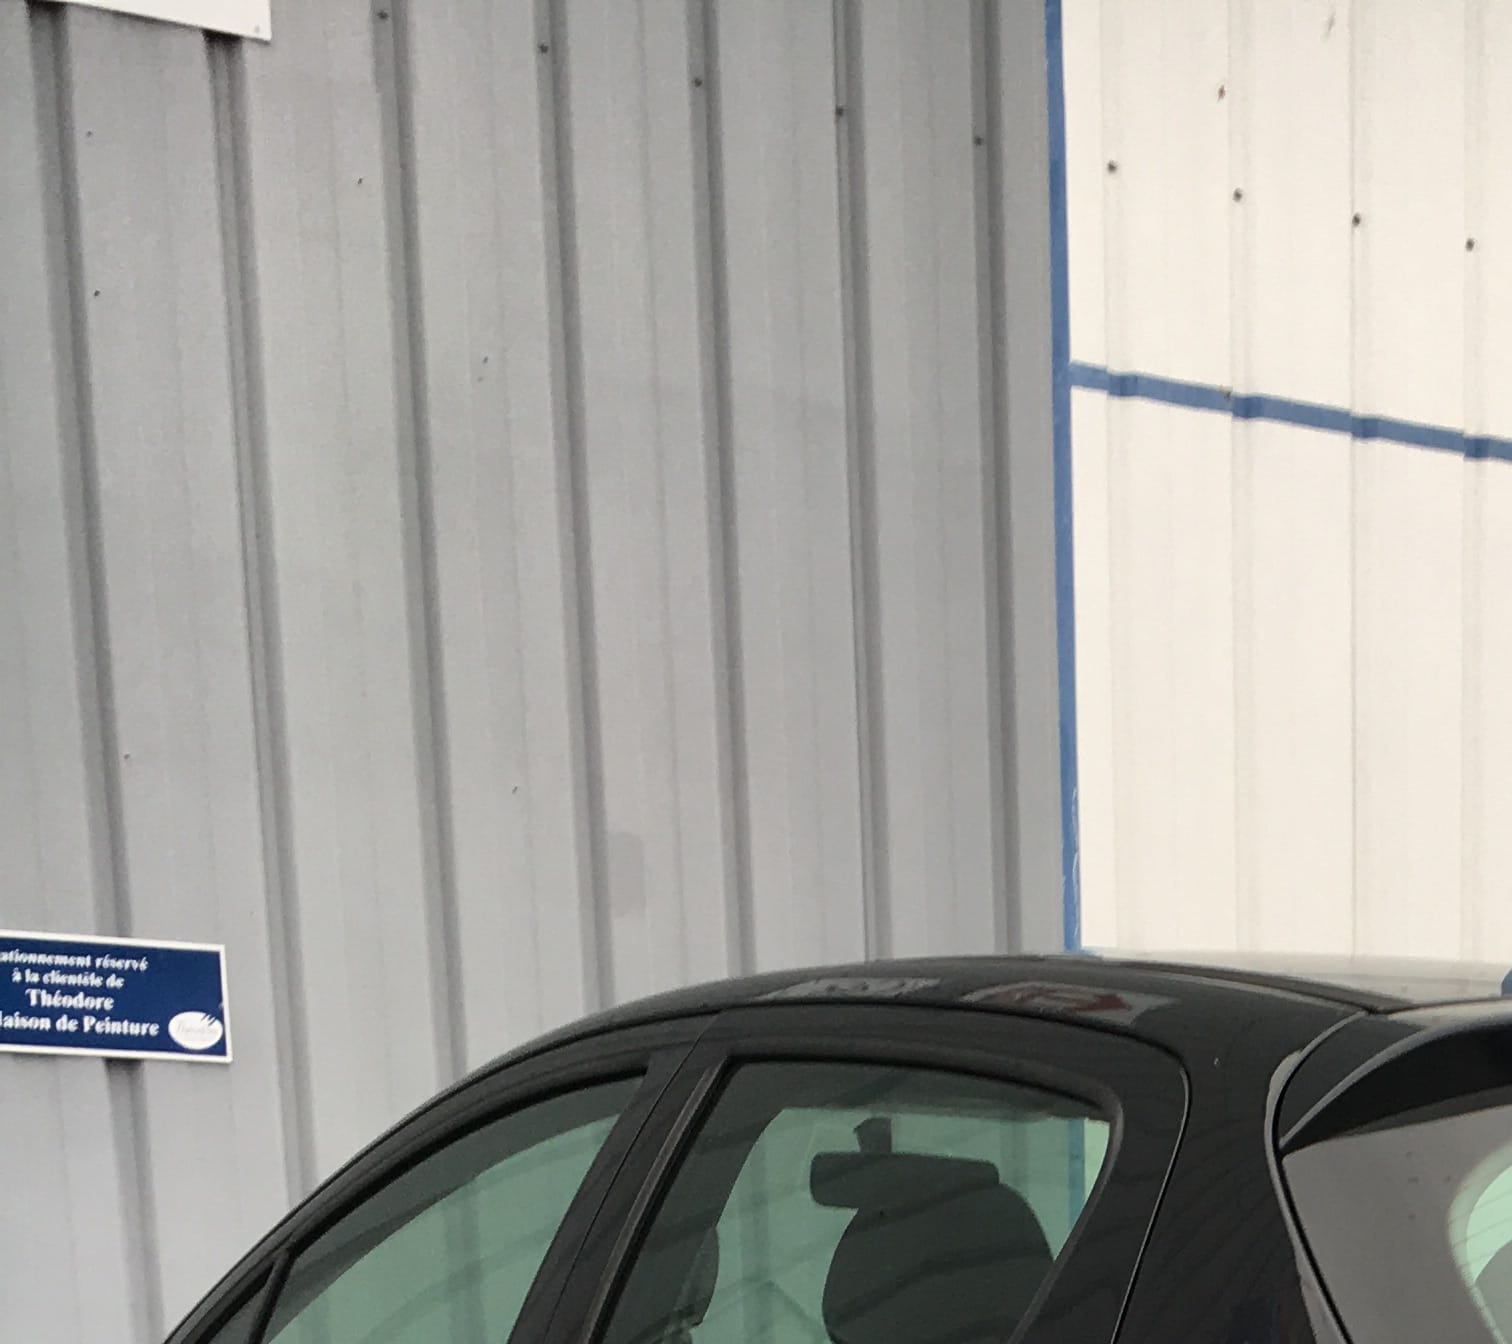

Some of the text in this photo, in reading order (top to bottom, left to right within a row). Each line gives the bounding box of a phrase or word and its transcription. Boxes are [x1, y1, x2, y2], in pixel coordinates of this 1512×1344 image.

[95, 954, 148, 972] réservé
[12, 967, 125, 990] à la clientèle de
[25, 988, 115, 1010] Théodore
[0, 1011, 51, 1032] aison
[55, 1014, 79, 1033] de
[83, 1015, 160, 1037] Peinture
